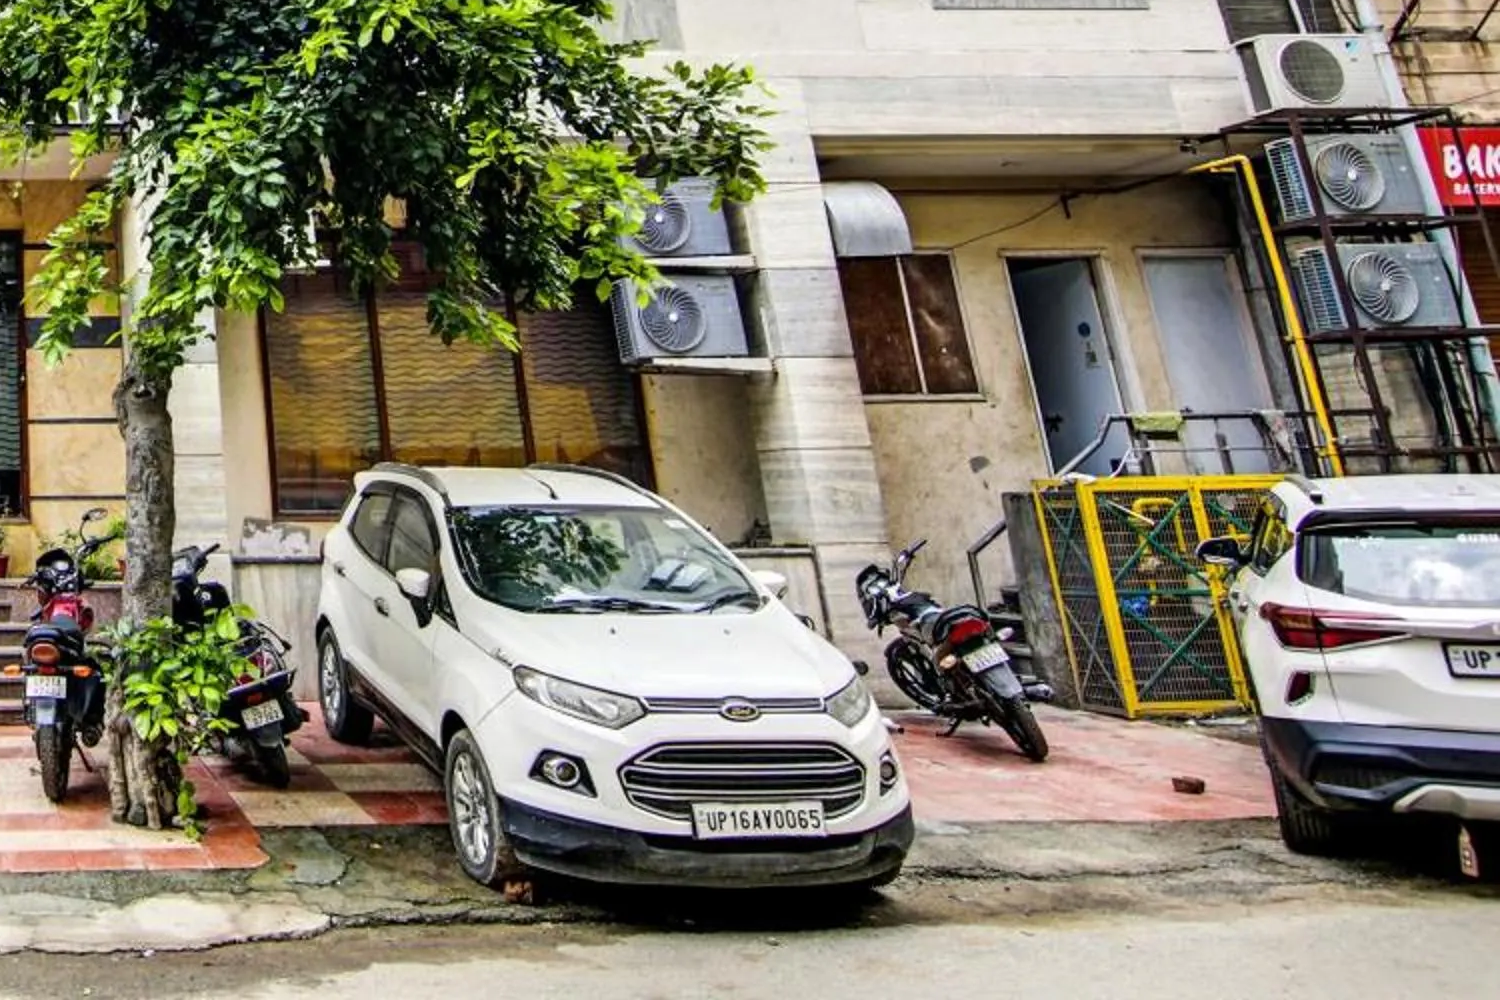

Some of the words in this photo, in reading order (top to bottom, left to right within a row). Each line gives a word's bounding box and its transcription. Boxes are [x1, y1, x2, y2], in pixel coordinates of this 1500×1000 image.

[1442, 143, 1500, 179] BAK
[1463, 650, 1500, 669] UP
[706, 809, 821, 832] UP16AV0065
